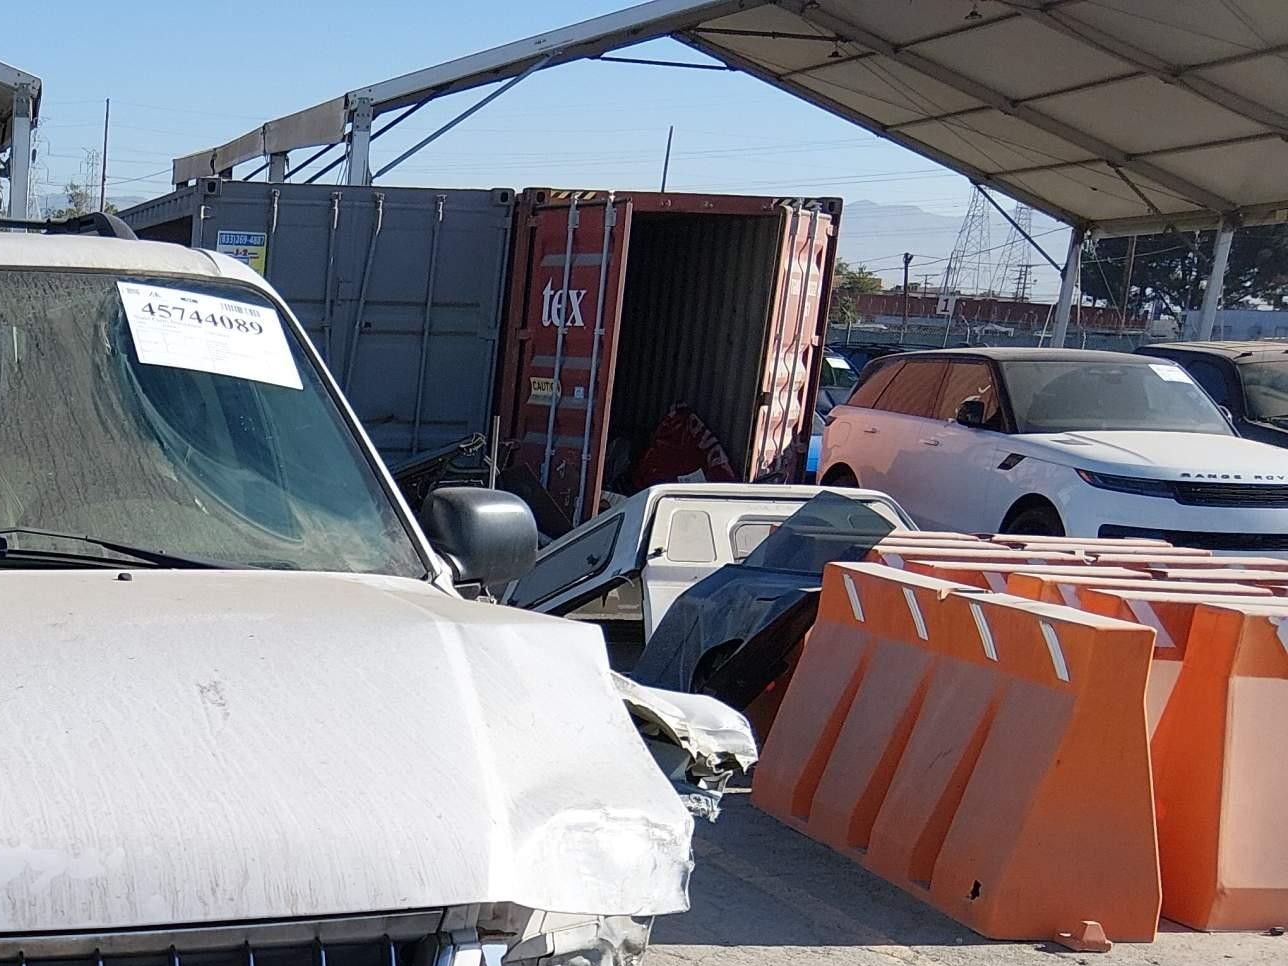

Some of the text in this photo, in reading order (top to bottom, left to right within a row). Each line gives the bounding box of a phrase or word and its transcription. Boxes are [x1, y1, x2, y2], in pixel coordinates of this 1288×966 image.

[940, 298, 950, 313] 1
[141, 301, 264, 336] 45744089
[1180, 472, 1242, 480] RANGE
